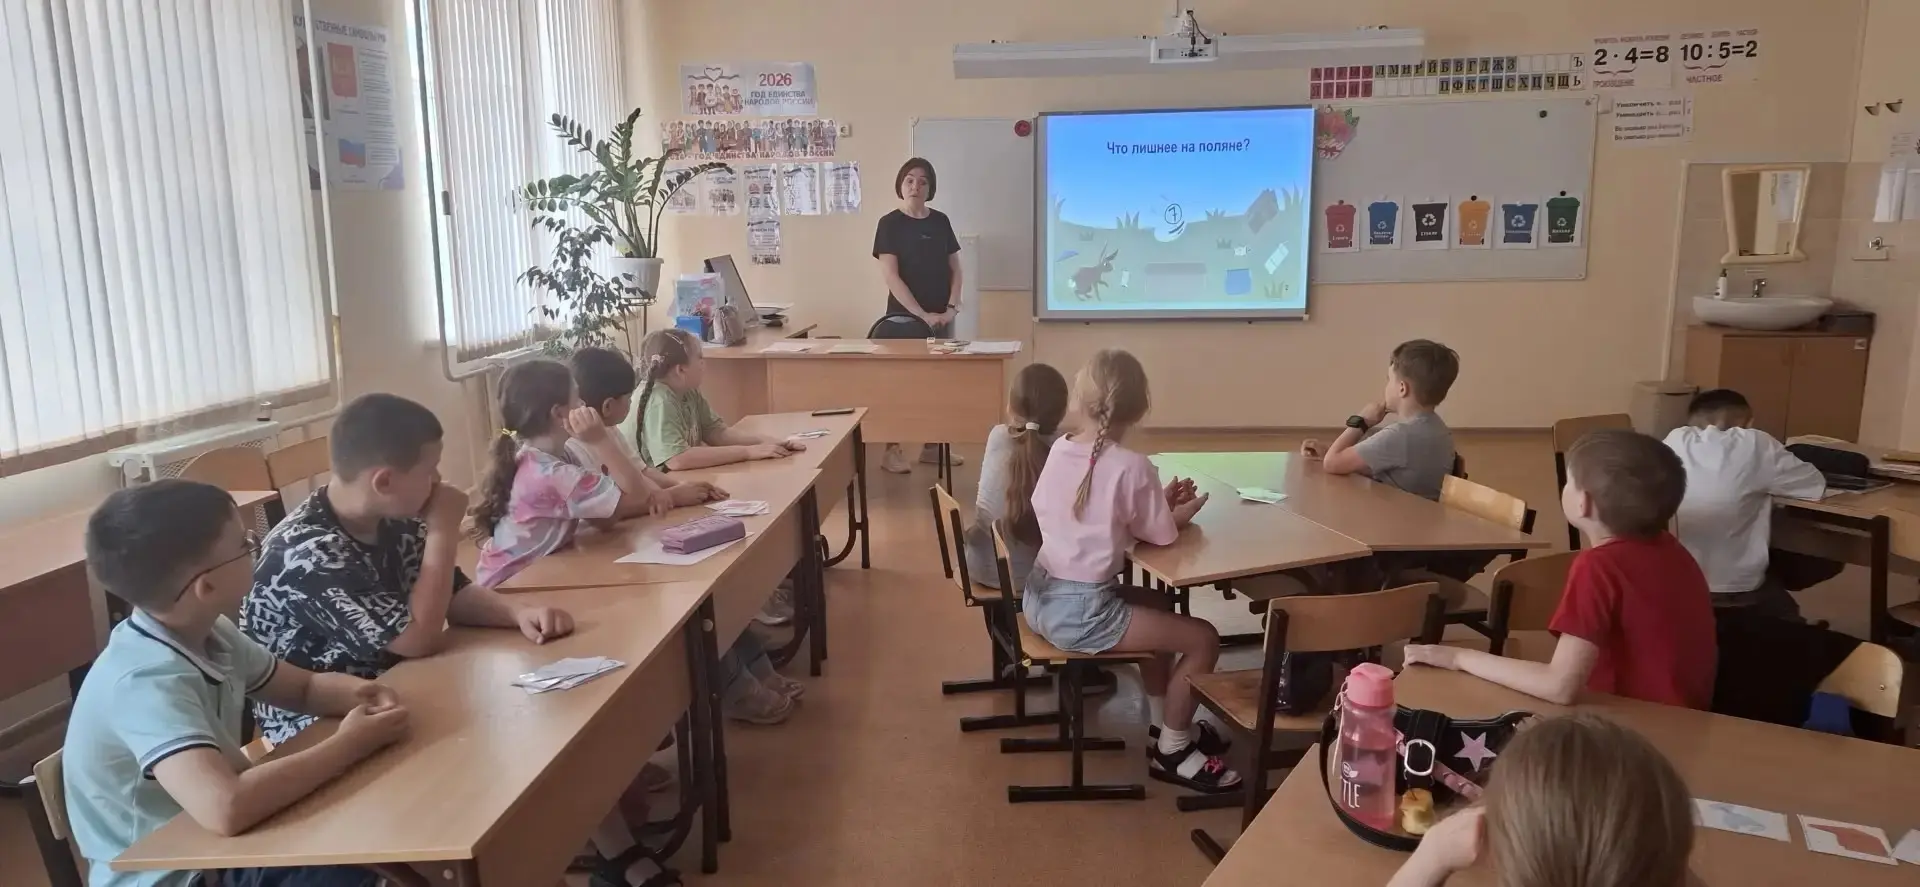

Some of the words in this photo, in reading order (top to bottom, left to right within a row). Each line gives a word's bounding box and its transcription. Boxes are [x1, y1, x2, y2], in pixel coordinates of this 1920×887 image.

[1594, 48, 1607, 65] 2
[1680, 44, 1703, 61] 10
[1388, 65, 1399, 75] М
[1415, 63, 1423, 74] Р
[1441, 61, 1449, 72] Б
[1455, 61, 1463, 72] В
[1469, 60, 1476, 71] Г
[1480, 60, 1488, 72] Д
[1493, 60, 1504, 71] Ж
[1507, 59, 1515, 70] З
[1574, 56, 1583, 67] Ъ
[759, 73, 792, 86] 2026
[1440, 80, 1449, 91] П
[1453, 79, 1464, 90] Ф
[1467, 79, 1476, 90] К
[1480, 78, 1489, 90] Т
[1492, 78, 1502, 89] Ш
[1506, 78, 1514, 88] С
[1520, 77, 1528, 88] Х
[1546, 76, 1554, 87] Ч
[1573, 75, 1581, 86] Ь
[1686, 74, 1723, 83] ЧАСТНОЕ
[768, 90, 805, 98] ЕДИНСТВА
[1107, 141, 1128, 155] Что
[1131, 142, 1178, 155] лишнее
[1181, 143, 1195, 153] на
[1198, 138, 1251, 153] поляне?
[694, 152, 712, 160] ГОД
[1342, 779, 1361, 809] TLE
